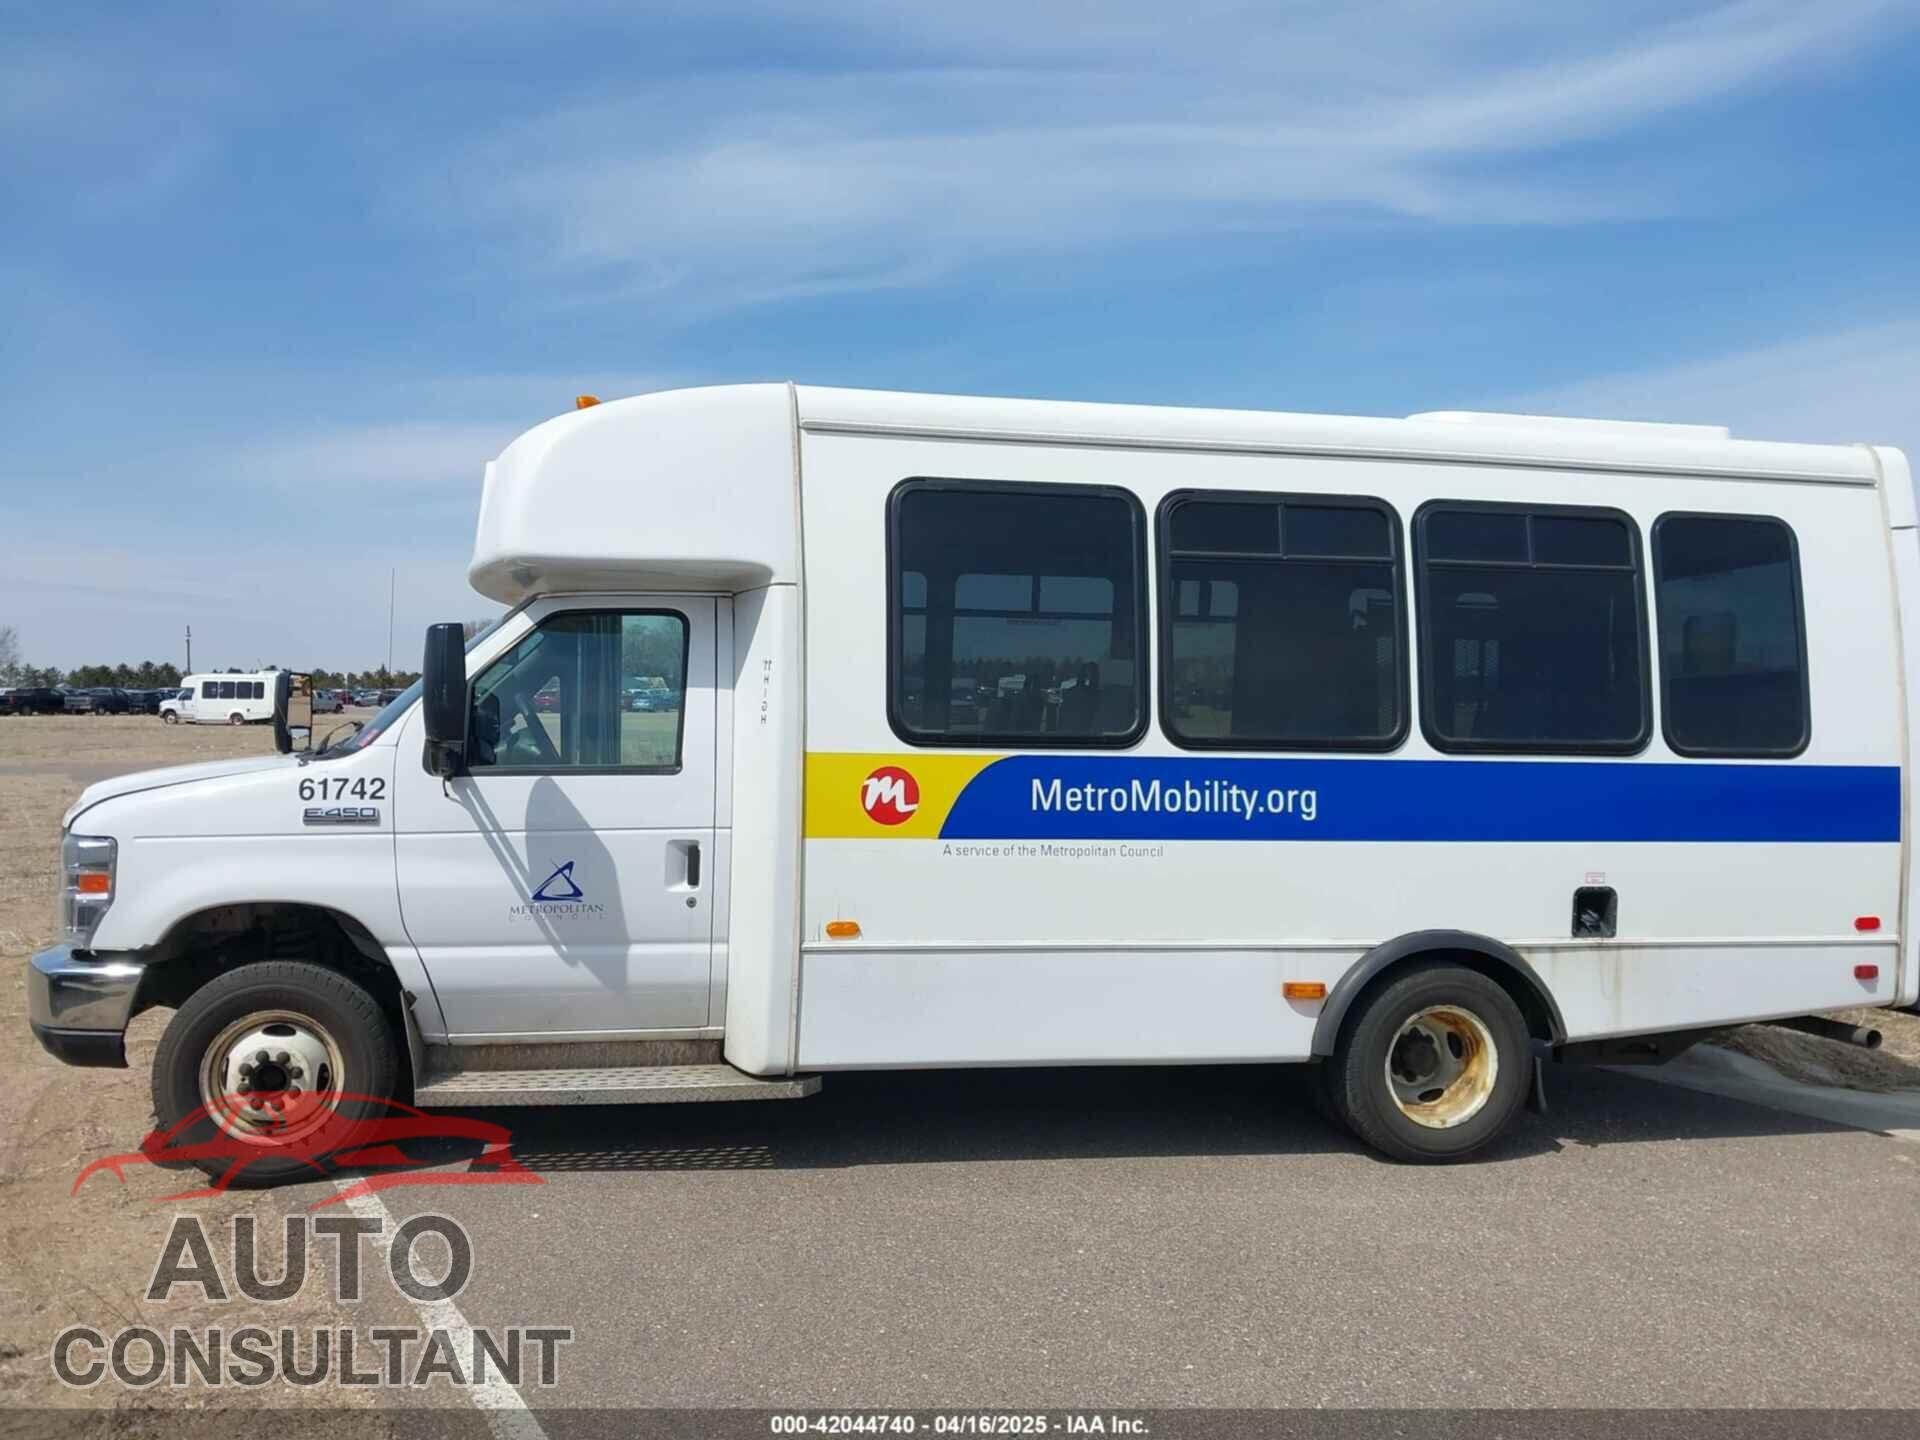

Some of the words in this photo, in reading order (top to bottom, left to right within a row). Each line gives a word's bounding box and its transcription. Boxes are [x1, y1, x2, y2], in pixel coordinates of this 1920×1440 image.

[299, 777, 386, 801] 61742
[1031, 779, 1317, 820] MetroMobility.org
[943, 844, 952, 856] A
[956, 845, 999, 857] service
[1003, 844, 1015, 857] of
[1017, 845, 1037, 857] the
[1040, 845, 1116, 859] Metropolitan
[1120, 845, 1164, 857] Council
[510, 903, 604, 914] METROPOLITAN
